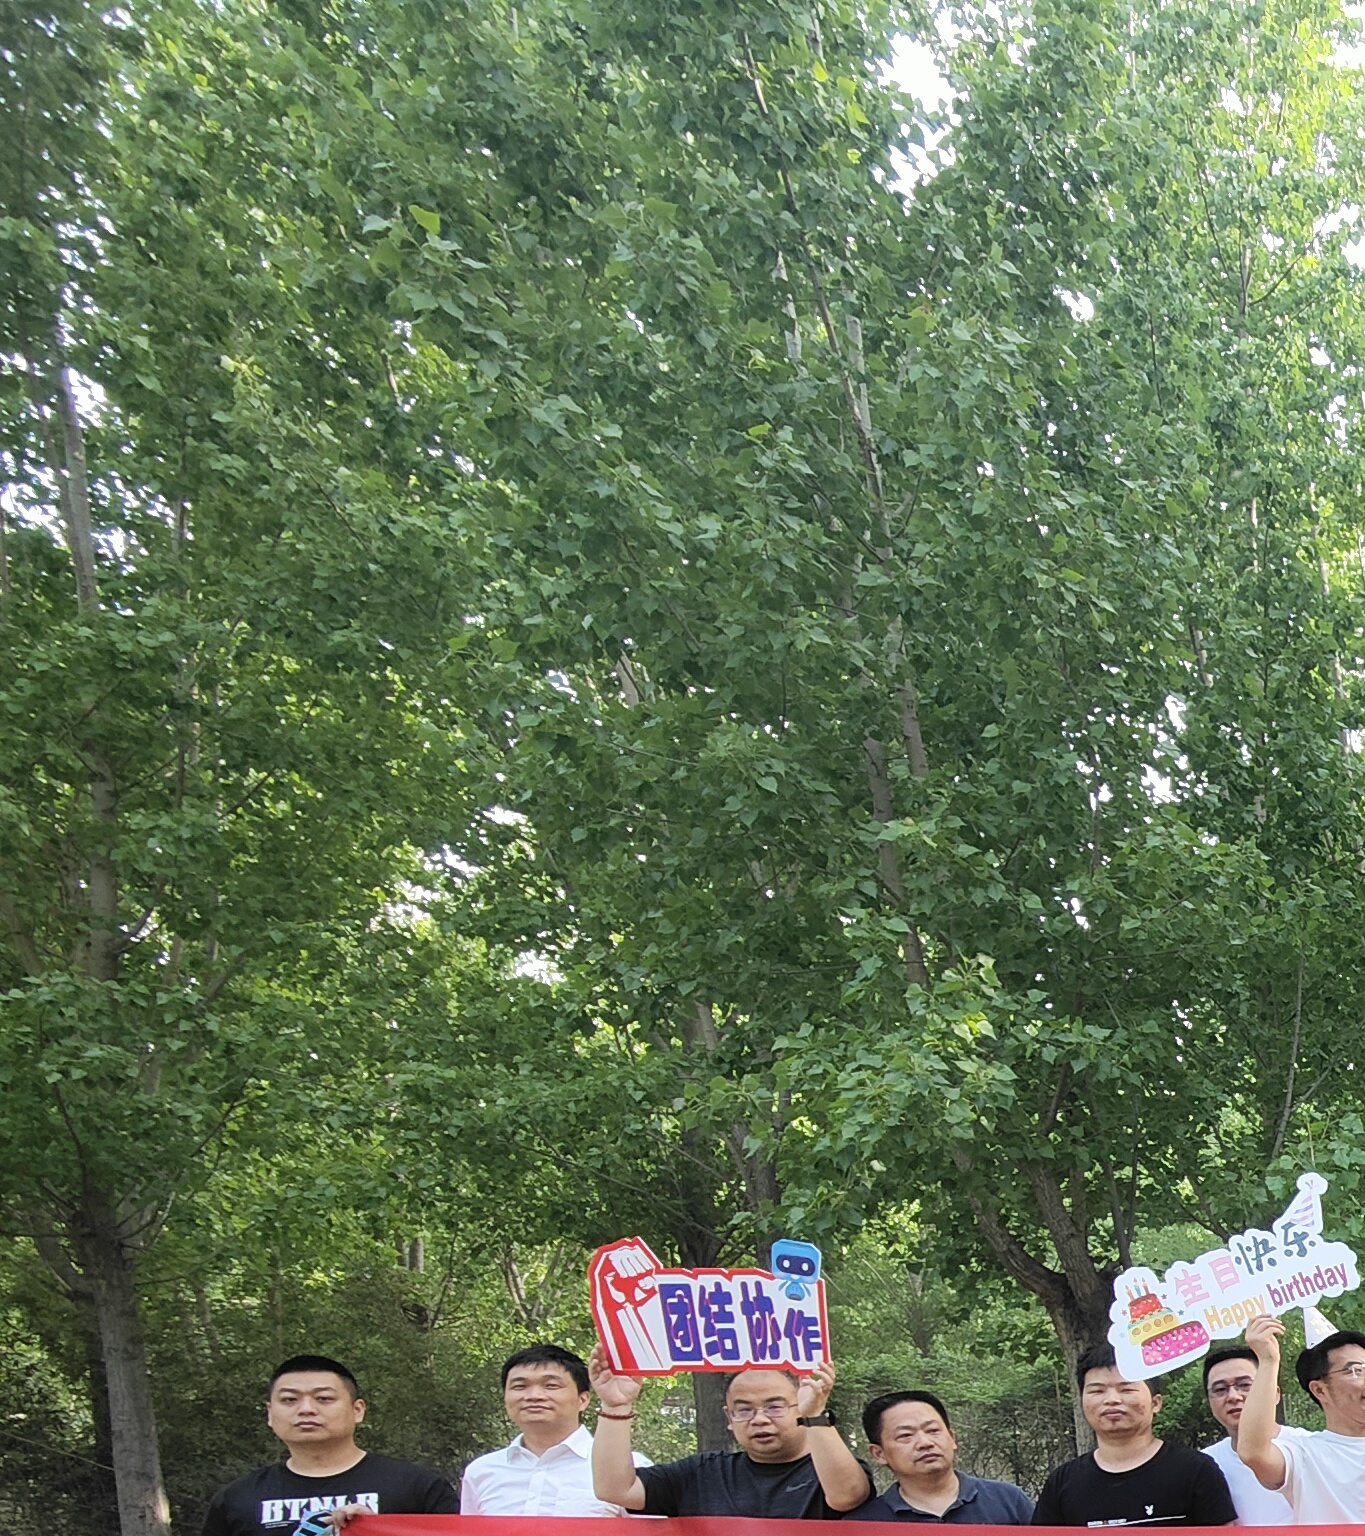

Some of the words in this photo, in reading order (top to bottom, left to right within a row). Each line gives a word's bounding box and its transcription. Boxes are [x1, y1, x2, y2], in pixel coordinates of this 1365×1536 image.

[1175, 1221, 1316, 1308] 生日快乐
[1203, 1294, 1267, 1332] Happy
[1266, 1262, 1349, 1309] birthday
[658, 1281, 823, 1363] 团结协作
